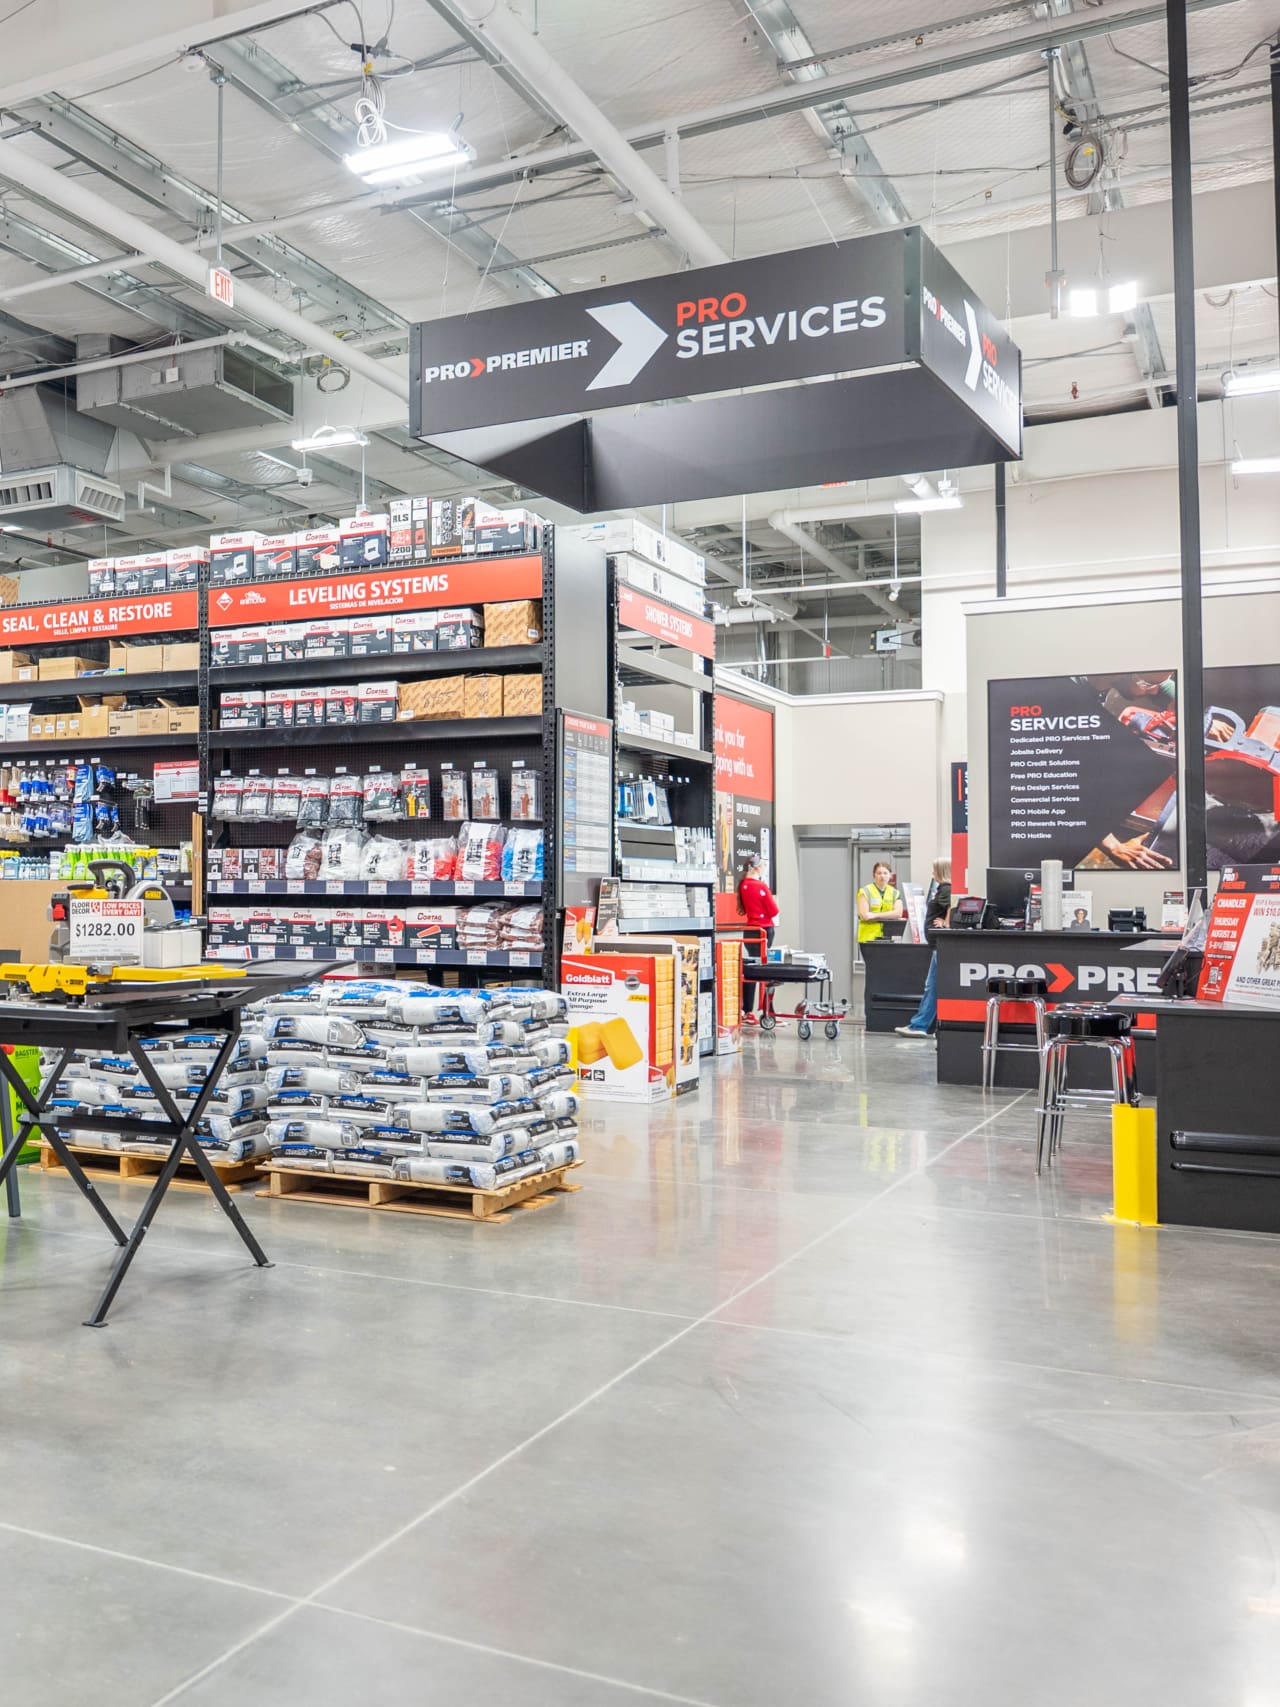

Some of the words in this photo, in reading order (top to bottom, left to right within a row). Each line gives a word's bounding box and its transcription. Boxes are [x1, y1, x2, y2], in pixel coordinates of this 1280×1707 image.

[215, 271, 233, 303] EXIT
[676, 292, 747, 326] PRO
[676, 296, 887, 360] SERVICES
[425, 361, 470, 384] PRO
[486, 339, 591, 373] PREMIER
[982, 331, 998, 367] PRO
[289, 582, 367, 606] LEVELING
[370, 574, 449, 597] SYSTEMS
[2, 615, 40, 633] SEAL,
[43, 610, 91, 628] CLEAN
[93, 608, 105, 623] &
[108, 601, 173, 622] RESTORE
[644, 604, 669, 628] SHOWER
[669, 614, 694, 639] SYSTEMS
[1010, 705, 1042, 717] PRO
[1010, 715, 1101, 731] SERVICES
[724, 729, 736, 749] you
[736, 728, 746, 749] for
[715, 752, 733, 778] pping
[733, 757, 746, 777] with
[1035, 748, 1063, 756] Delivery
[1027, 784, 1050, 792] Design
[75, 922, 135, 937] $1282.00
[417, 911, 443, 922] CORTAG
[565, 974, 610, 984] Goldblatt
[959, 963, 1046, 987] PRO
[1078, 965, 1163, 993] PRE
[1247, 976, 1261, 985] OTHER
[1262, 977, 1276, 986] GREAT
